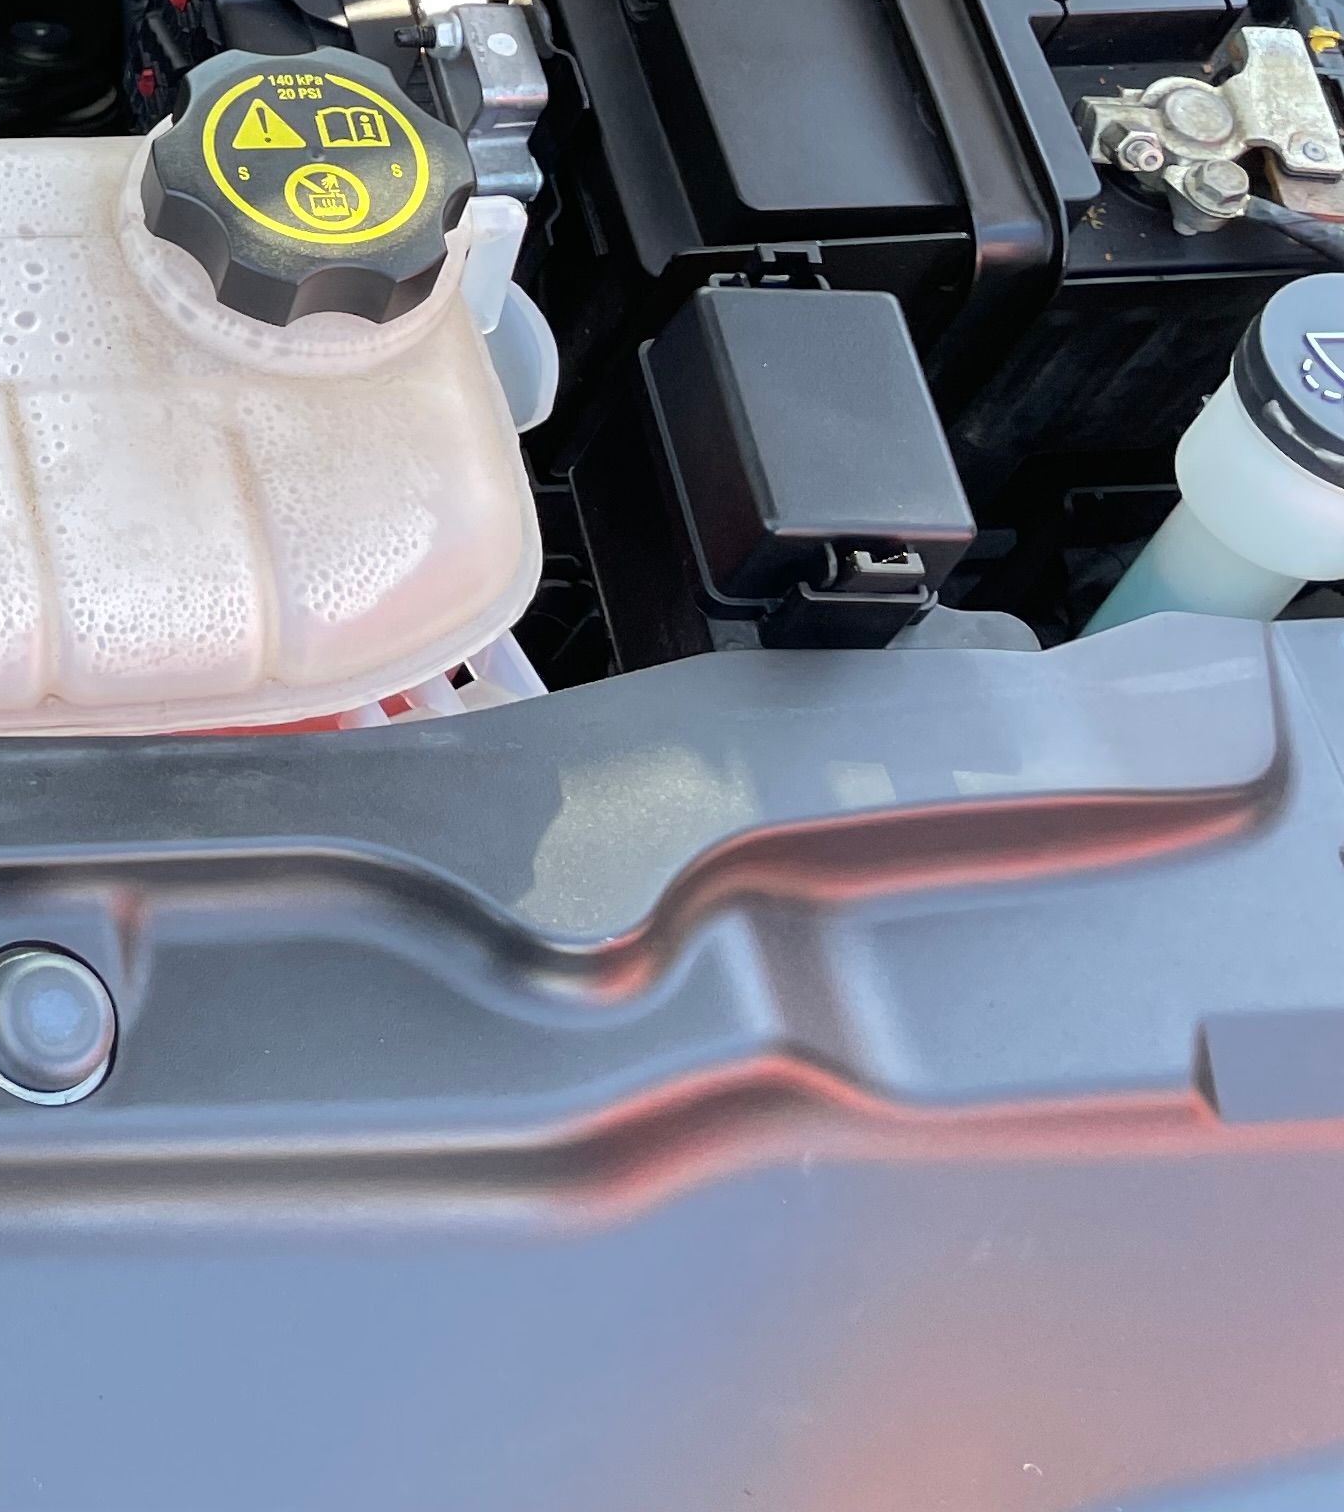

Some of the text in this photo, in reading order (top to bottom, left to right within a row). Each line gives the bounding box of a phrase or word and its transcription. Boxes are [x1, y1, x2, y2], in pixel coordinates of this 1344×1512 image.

[268, 74, 324, 87] 140 kPa
[277, 87, 322, 100] 20 PSI
